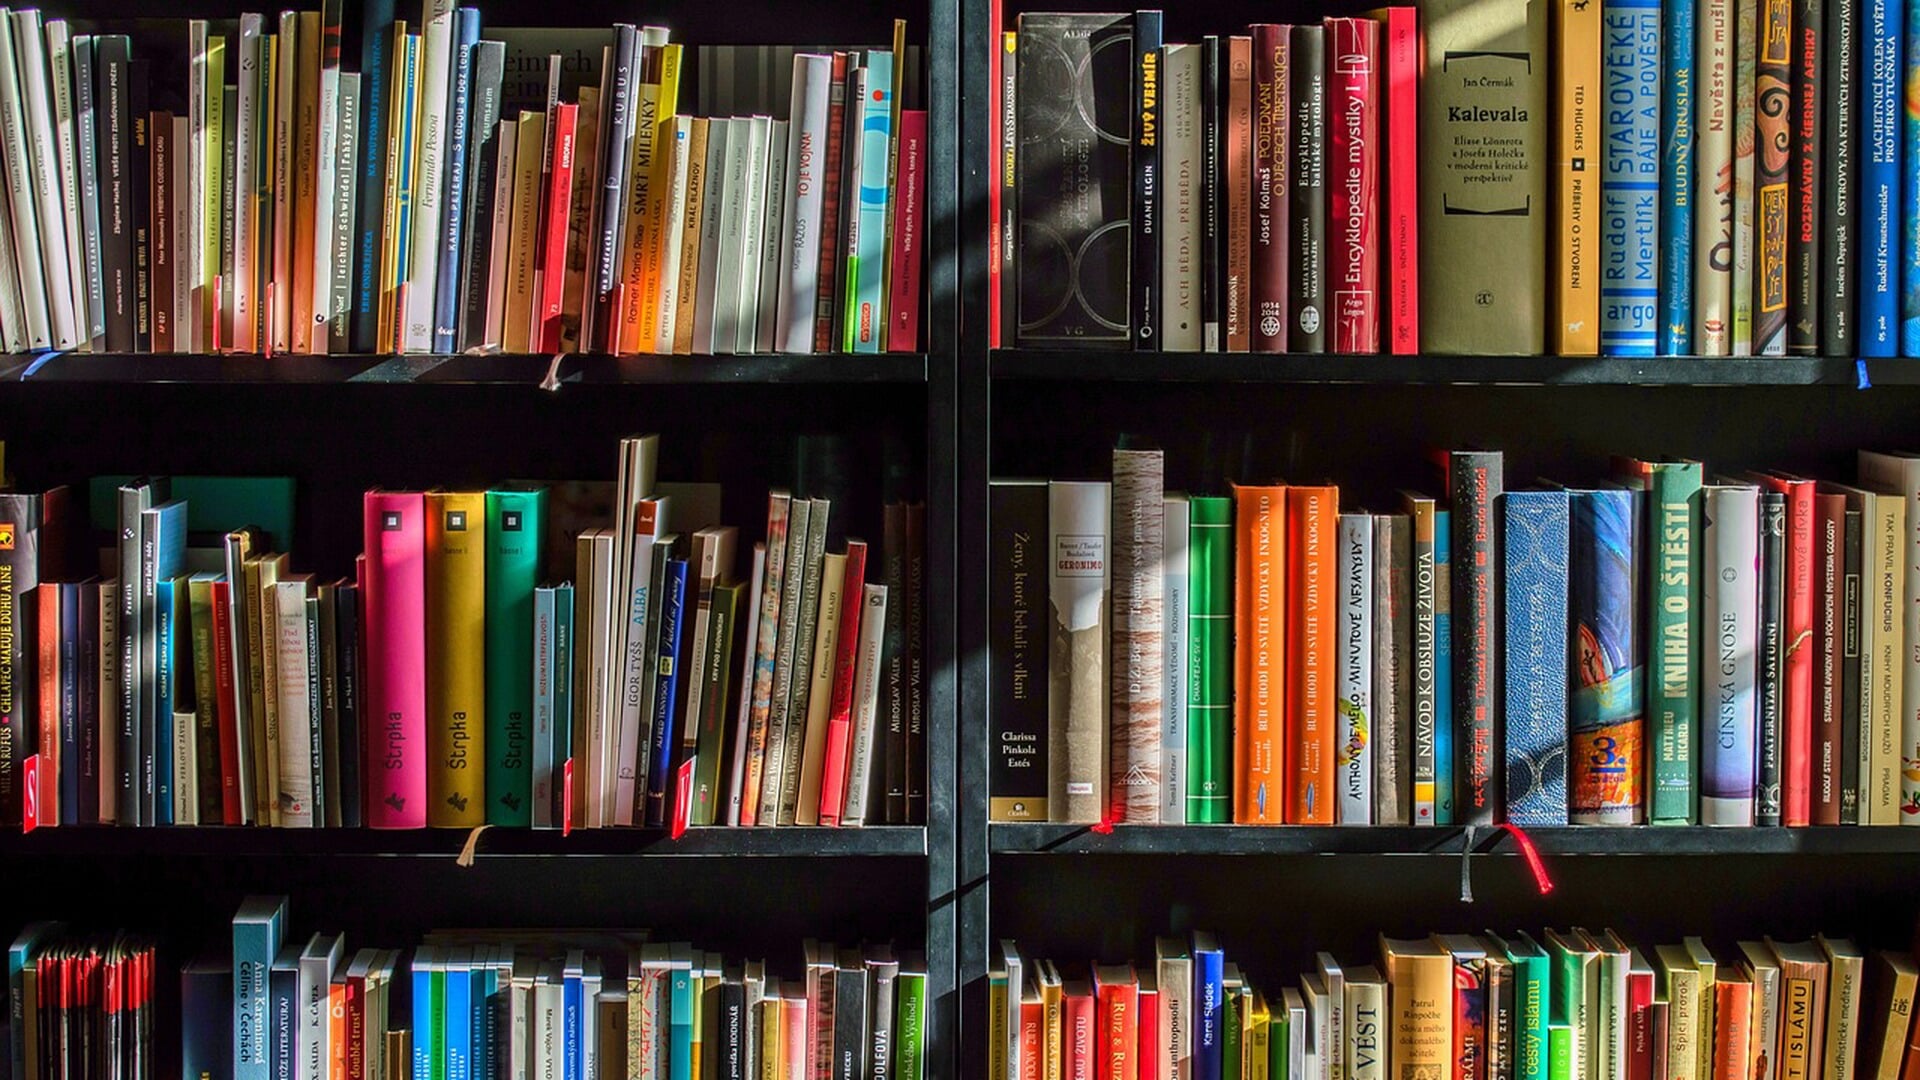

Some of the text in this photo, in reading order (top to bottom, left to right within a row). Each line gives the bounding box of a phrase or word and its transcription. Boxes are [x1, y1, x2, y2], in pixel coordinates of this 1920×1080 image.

[456, 72, 467, 94] bez
[457, 43, 469, 69] teba
[1463, 77, 1514, 89] Jan Čermák
[1802, 28, 1815, 79] AFRIKY
[343, 95, 353, 129] závrat
[614, 65, 628, 125] KUBUS
[1141, 52, 1157, 146] ŽIVÝ VESMÍR
[1257, 83, 1272, 158] POJEDNÁNÍ
[1272, 46, 1287, 196] O VĚCECH TIBETSKÝCH
[1448, 106, 1528, 122] Kalevala
[1574, 85, 1584, 150] TED HUGHES
[1605, 14, 1635, 173] STAROVĚKÉ
[1639, 14, 1658, 173] BÁJE A POVĚSTI
[1676, 68, 1689, 137] BRUSLAŘ
[1709, 48, 1725, 131] Nevěsta z
[1800, 83, 1815, 138] ČIERNEJ
[1872, 38, 1885, 163] PLACHETNICÍ KOLEM
[1884, 36, 1896, 163] PRO PÍRKO TUČŇÁKA
[452, 107, 465, 140] tebou
[452, 144, 462, 152] S
[1298, 102, 1310, 186] Encyklopedie
[1311, 75, 1323, 187] baltské mytologie
[1344, 96, 1361, 163] mystiky
[1454, 137, 1523, 146] Eliase Lönnrota
[1460, 149, 1486, 160] Josefa
[1488, 149, 1524, 158] Holečka
[422, 114, 439, 208] Fernando Pessoa
[633, 98, 655, 216] SMRŤ MILENKY
[798, 132, 812, 197] TO JE VOJNA!
[1454, 161, 1493, 170] moderní
[1495, 161, 1529, 170] kritické
[1464, 174, 1512, 184] perspektivě
[1674, 140, 1689, 206] BLUDNÝ
[337, 174, 350, 279] leichter Schwindel
[447, 162, 461, 251] KAMIL PETERAJ
[1144, 165, 1153, 233] DUANE ELGIN
[1258, 167, 1271, 245] Josef Kolmaš
[1345, 167, 1361, 283] Encyklopedie
[1572, 225, 1580, 233] O
[1801, 159, 1813, 241] ROZPRÁVKY
[1178, 159, 1191, 310] ACH BĚDA, PŘEBĚDA
[1605, 195, 1626, 280] Rudolf
[1635, 196, 1653, 280] Mertlík
[1877, 184, 1889, 292] Rudolf Krautschneider
[627, 225, 644, 324] Rainer Maria Rilke
[1608, 305, 1654, 328] argo
[1, 584, 11, 592] A
[1059, 561, 1103, 569] GERONIMO
[633, 586, 647, 625] ALBA
[1256, 496, 1271, 731] BŮH CHODÍ PO SVĚTĚ VŽDYCKY INKOGNITO
[1305, 496, 1319, 731] BŮH CHODÍ PO SVĚTĚ VŽDYCKY INKOGNITO
[1347, 539, 1363, 685] MINUTOVÉ NESMYSLY
[1661, 503, 1689, 698] KNIHA O ŠTĚSTÍ
[627, 641, 643, 707] IGOR TYŠŠ
[1417, 552, 1432, 757] NÁVOD K OBSLUZE ŽIVOTA
[1717, 612, 1736, 749] ČÍNSKÁ GNOSE
[0, 665, 13, 713] CHLAPEC
[889, 657, 901, 733] MIROSLAV VÁLEK
[909, 658, 921, 734] MIROSLAV VÁLEK
[1765, 622, 1777, 769] FRATERNITAS SATURNI
[445, 712, 470, 769] Štrpka
[500, 712, 525, 769] Štrpka
[1002, 732, 1036, 742] Clarissa
[1002, 745, 1036, 755] Pinkola
[1008, 758, 1030, 768] Estés
[1663, 712, 1674, 760] MATTHIEU
[1678, 724, 1688, 760] RICARD
[1823, 741, 1832, 803] RUDOLF STEINER
[239, 961, 250, 998] Céline
[1677, 980, 1688, 1017] prorok
[1840, 974, 1852, 1019] meditace
[240, 1012, 253, 1062] Čechách
[254, 962, 265, 1064] Anna Kareninová
[904, 997, 918, 1038] Východu
[1074, 1016, 1086, 1054] ŽIVOTU
[1169, 999, 1180, 1067] anthroposofii
[1203, 983, 1214, 1046] Karel Sládek
[1351, 1004, 1376, 1070] VÉST
[1499, 1009, 1507, 1069] MYSL ZEN
[1525, 980, 1540, 1075] cesty islámu
[1789, 985, 1807, 1058] ISLÁMU
[350, 1041, 360, 1078] double
